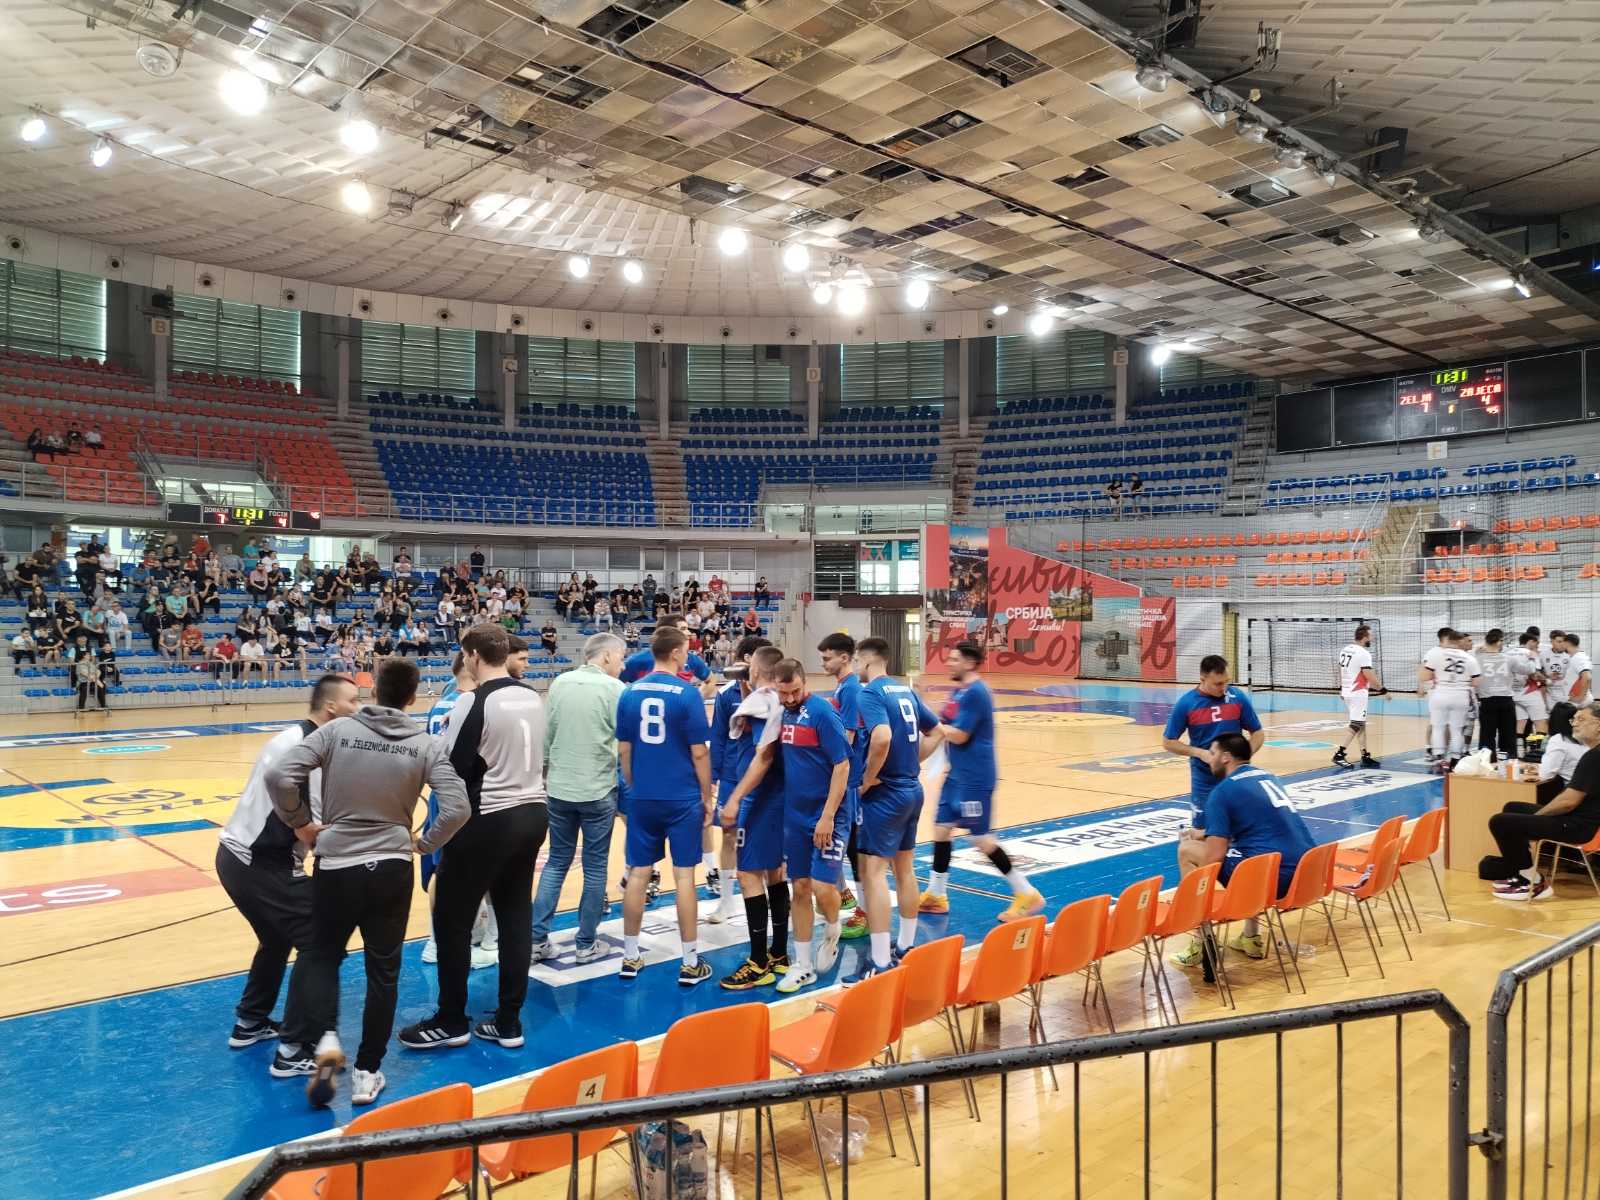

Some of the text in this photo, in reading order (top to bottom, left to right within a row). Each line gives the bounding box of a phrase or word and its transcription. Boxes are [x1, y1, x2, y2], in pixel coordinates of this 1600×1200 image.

[155, 320, 166, 333] B
[1116, 351, 1125, 363] E
[810, 369, 818, 380] D
[1436, 370, 1468, 384] 11:31
[217, 514, 225, 524] 7
[235, 508, 264, 519] 11:31
[278, 518, 287, 527] 4
[1006, 607, 1054, 620] СРБИЈА
[1339, 654, 1352, 667] 27
[1483, 662, 1508, 676] 34
[898, 698, 918, 743] 9
[1211, 706, 1222, 722] 2
[640, 698, 666, 744] 8
[341, 738, 349, 748] RK
[519, 718, 531, 772] 1
[1259, 779, 1298, 814] 4
[1094, 835, 1155, 850] City
[585, 1082, 597, 1099] 4
